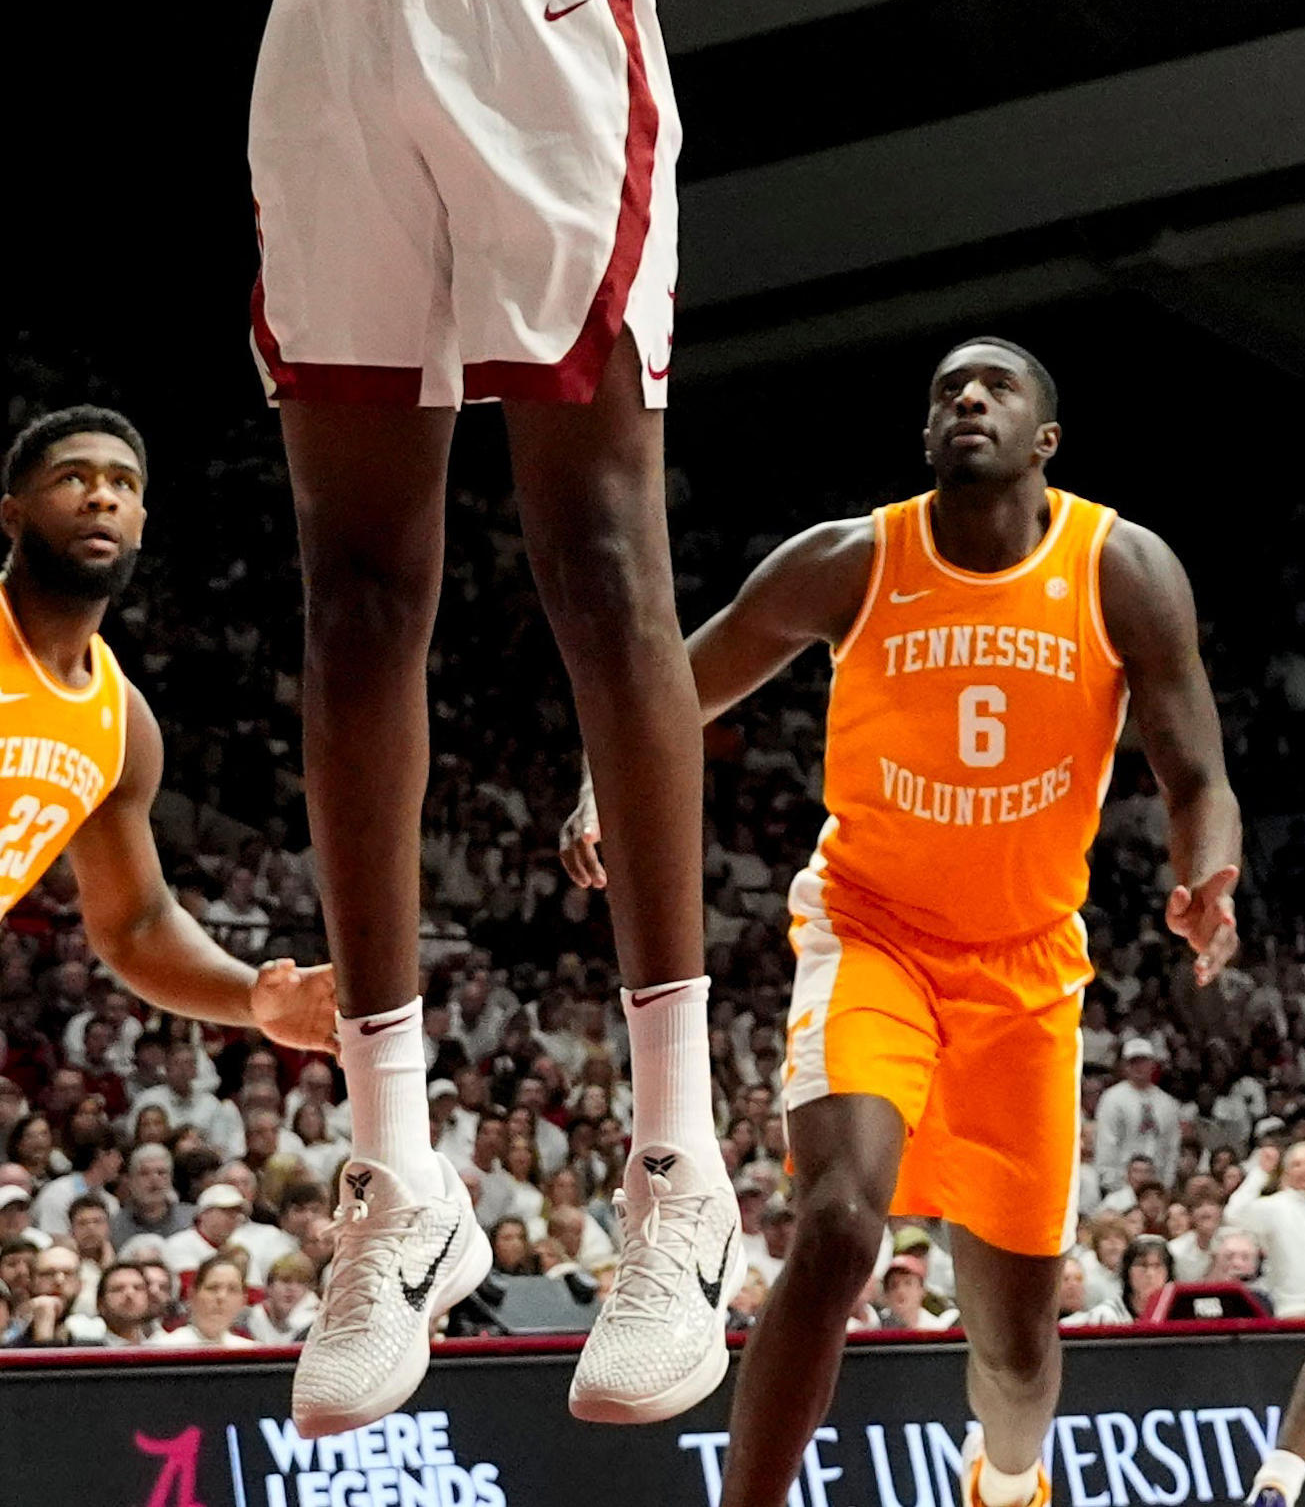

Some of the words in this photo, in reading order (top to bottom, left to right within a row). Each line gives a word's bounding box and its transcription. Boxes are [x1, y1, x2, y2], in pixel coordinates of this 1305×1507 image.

[883, 624, 1078, 683] TENNESSEE
[958, 684, 1008, 769] 6
[878, 755, 1074, 827] VOLUNTEERS
[258, 1409, 456, 1474] WHERE
[865, 1405, 1282, 1507] UNERSITY
[264, 1461, 508, 1507] LEGENDS
